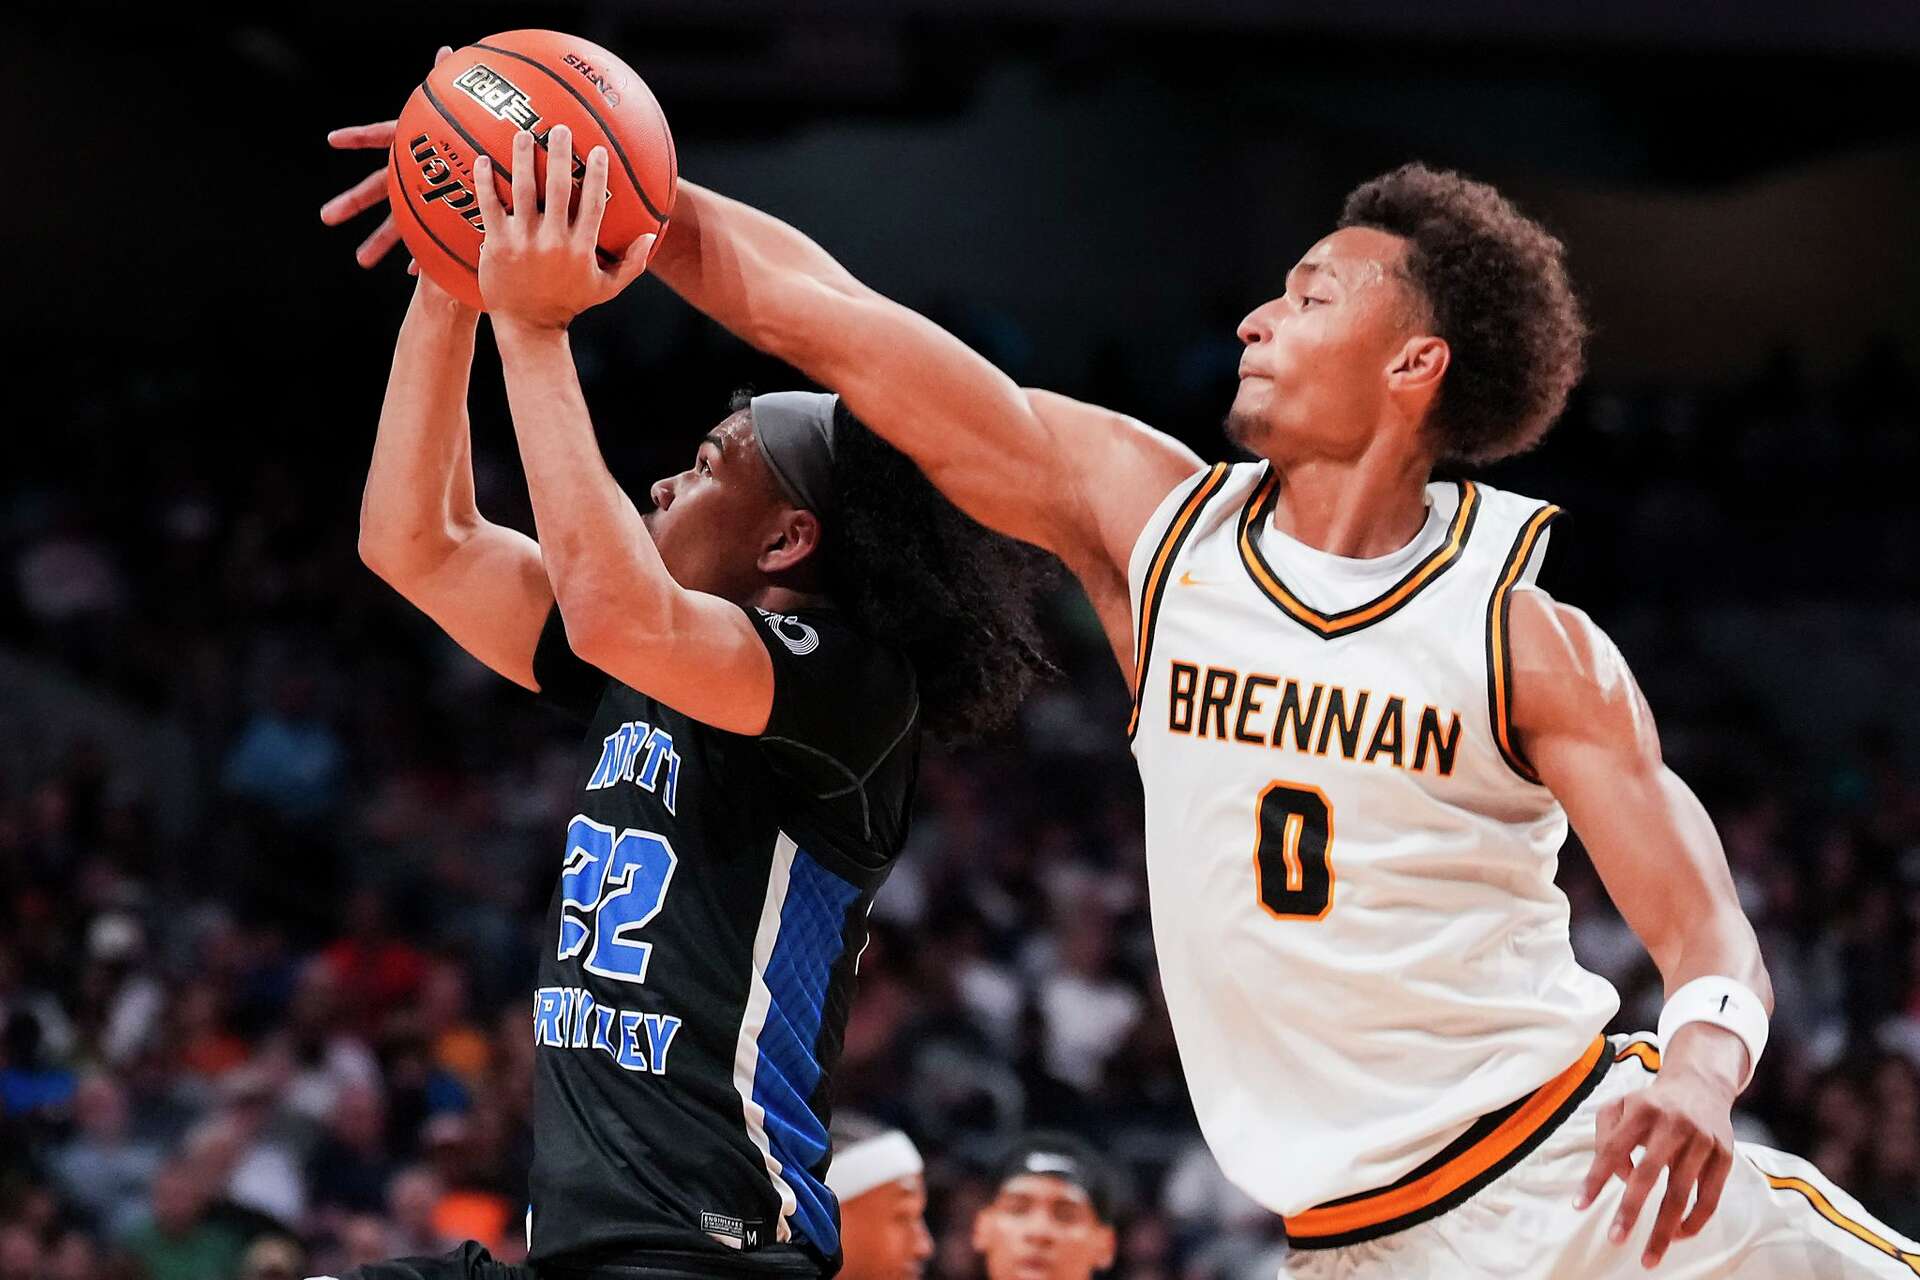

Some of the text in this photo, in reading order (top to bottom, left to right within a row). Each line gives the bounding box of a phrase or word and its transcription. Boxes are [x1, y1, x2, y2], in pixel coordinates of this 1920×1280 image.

[459, 67, 512, 109] PRO
[410, 133, 487, 233] aden
[1169, 659, 1463, 777] BRENNAN
[557, 813, 678, 984] 22
[1253, 779, 1335, 922] 0
[746, 1230, 757, 1246] M
